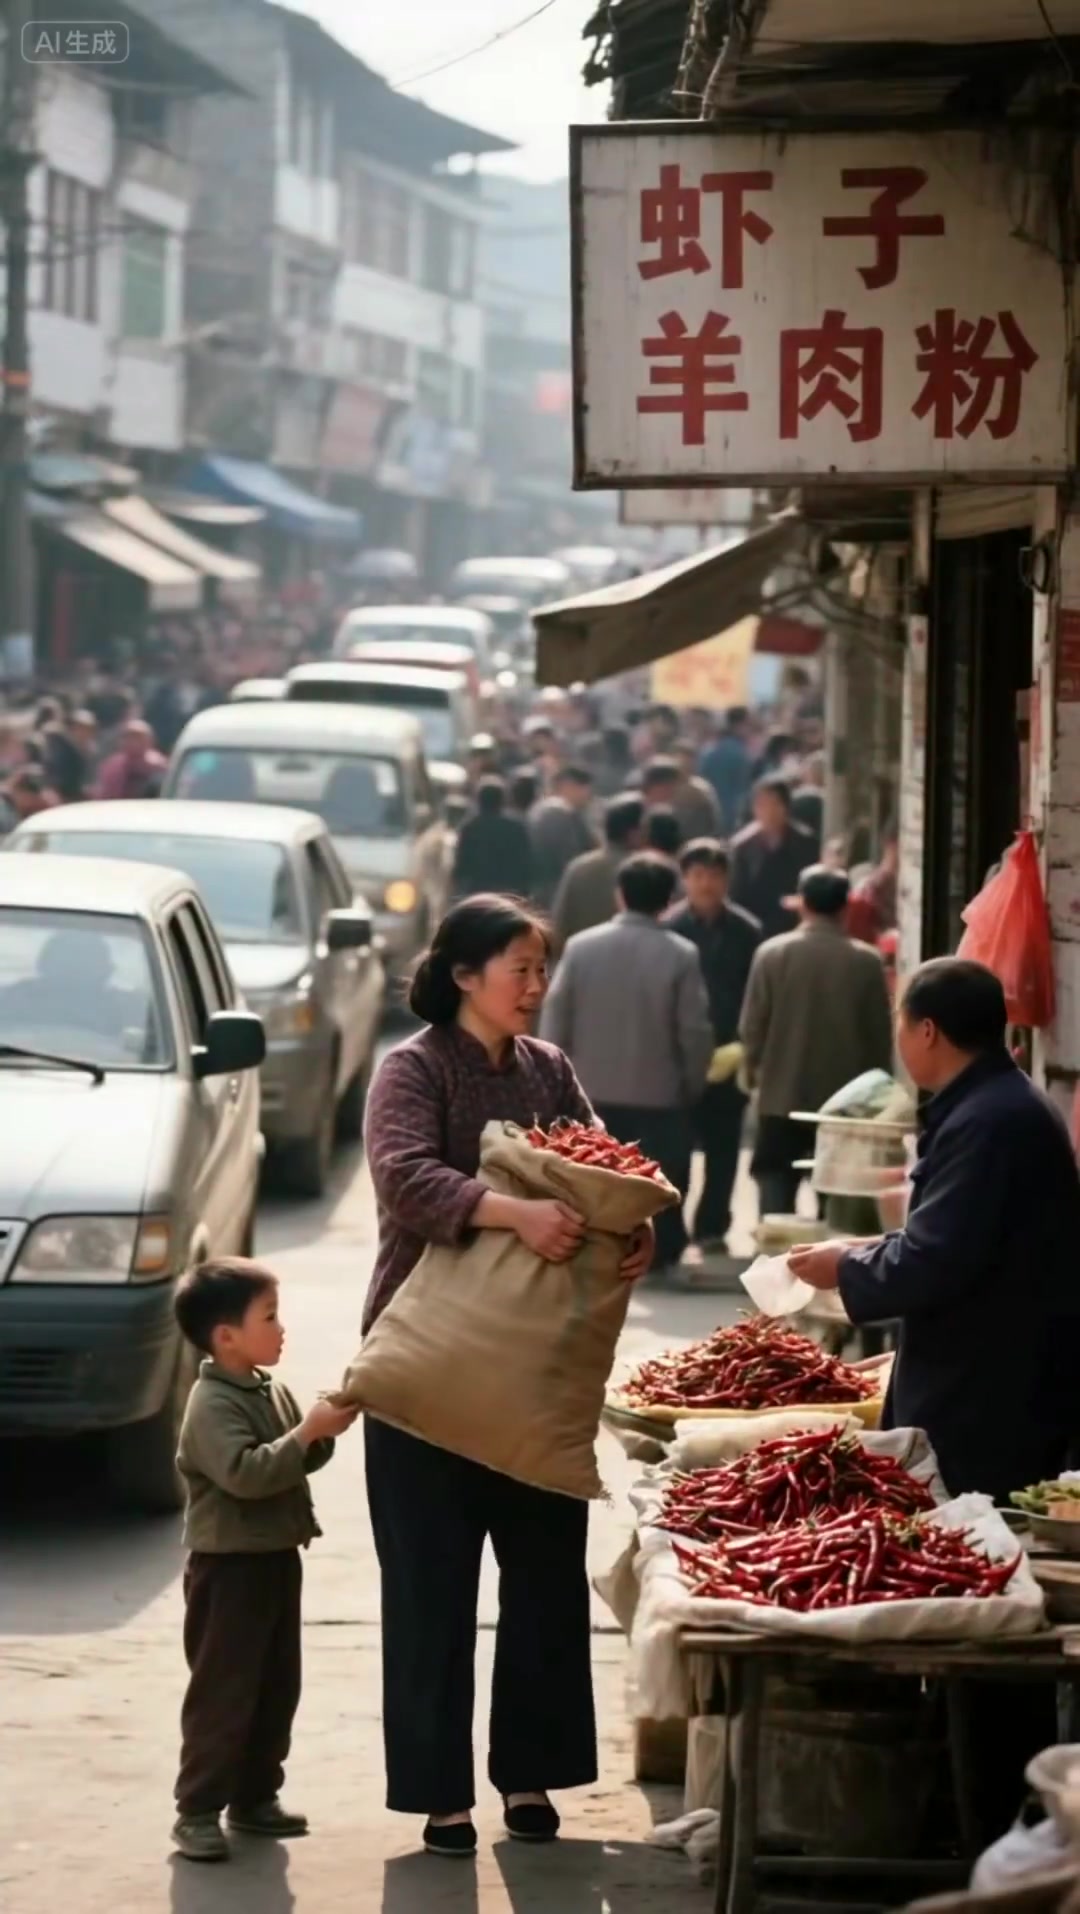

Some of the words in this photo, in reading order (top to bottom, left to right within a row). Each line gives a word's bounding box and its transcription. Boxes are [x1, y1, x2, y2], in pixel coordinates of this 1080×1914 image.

[637, 164, 945, 290] 虾子
[637, 308, 1040, 446] 羊肉粉
